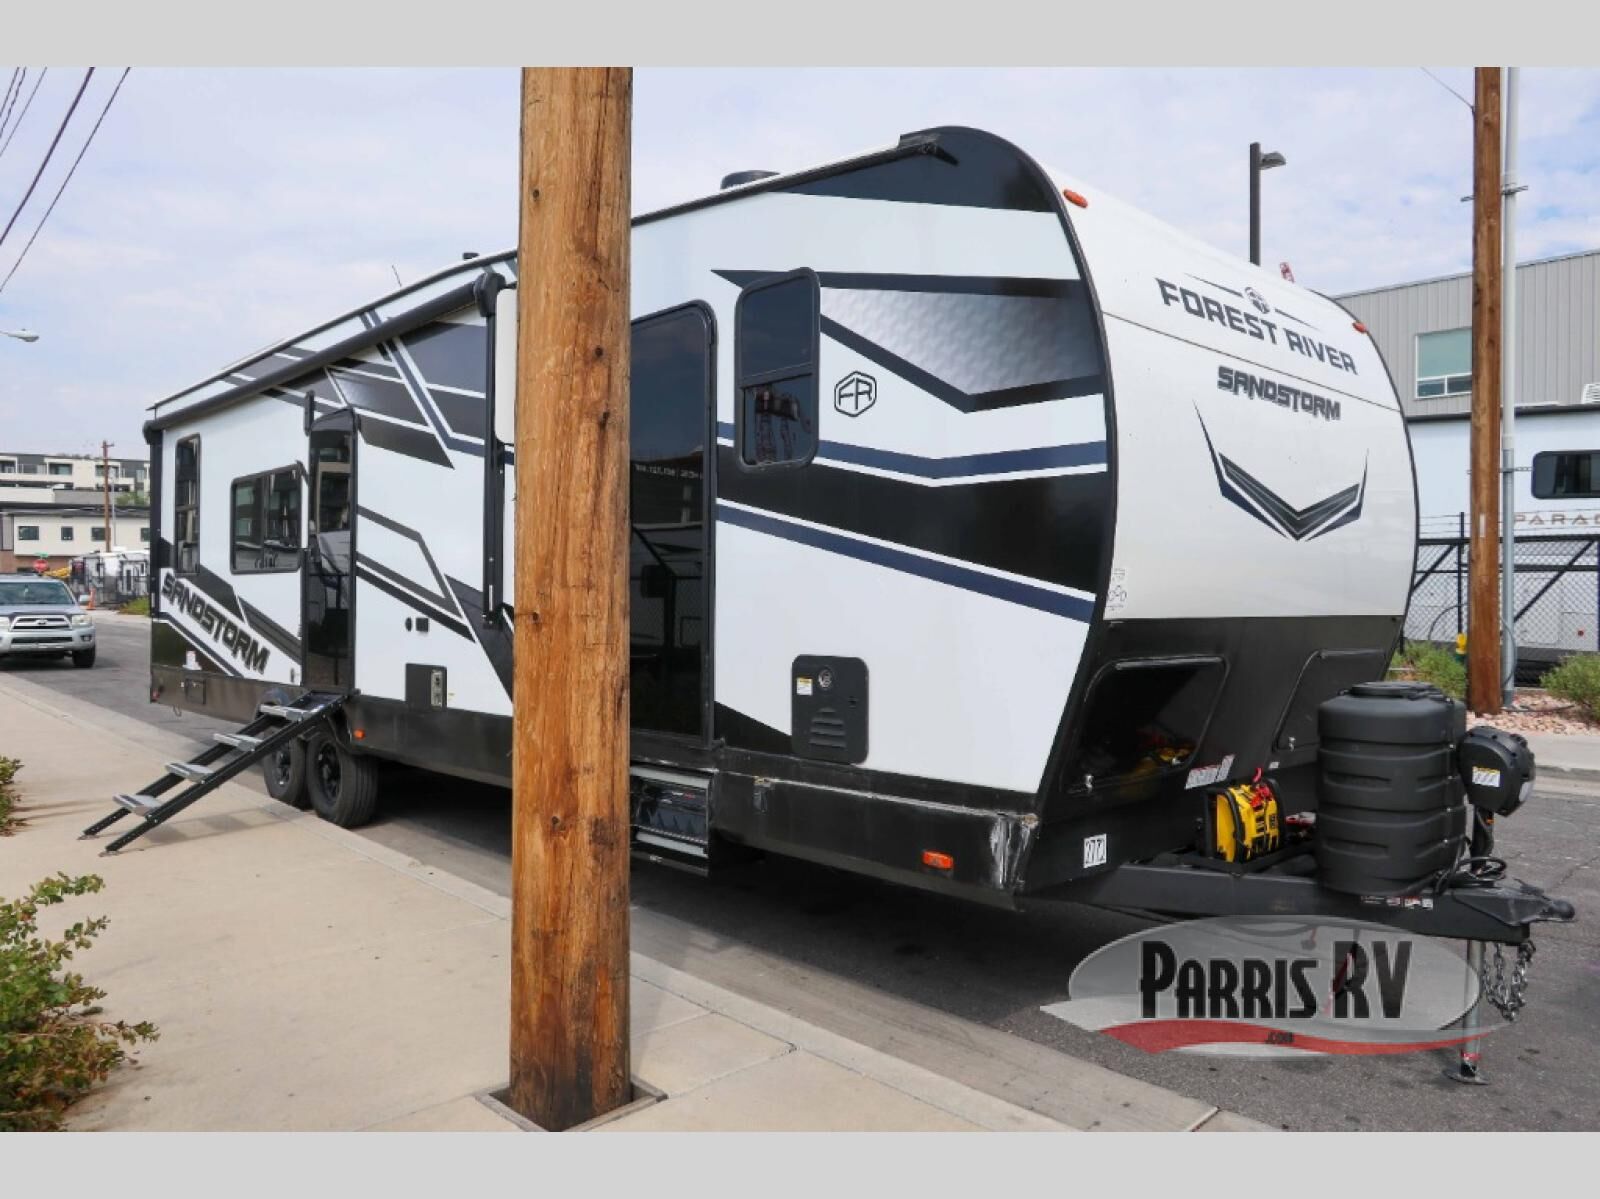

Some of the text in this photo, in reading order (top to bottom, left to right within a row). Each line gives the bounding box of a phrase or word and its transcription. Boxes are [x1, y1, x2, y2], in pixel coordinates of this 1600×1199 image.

[1155, 277, 1359, 376] FOREST RIVER
[1217, 365, 1341, 421] SANDSTORM
[162, 571, 271, 676] SANDSTORM
